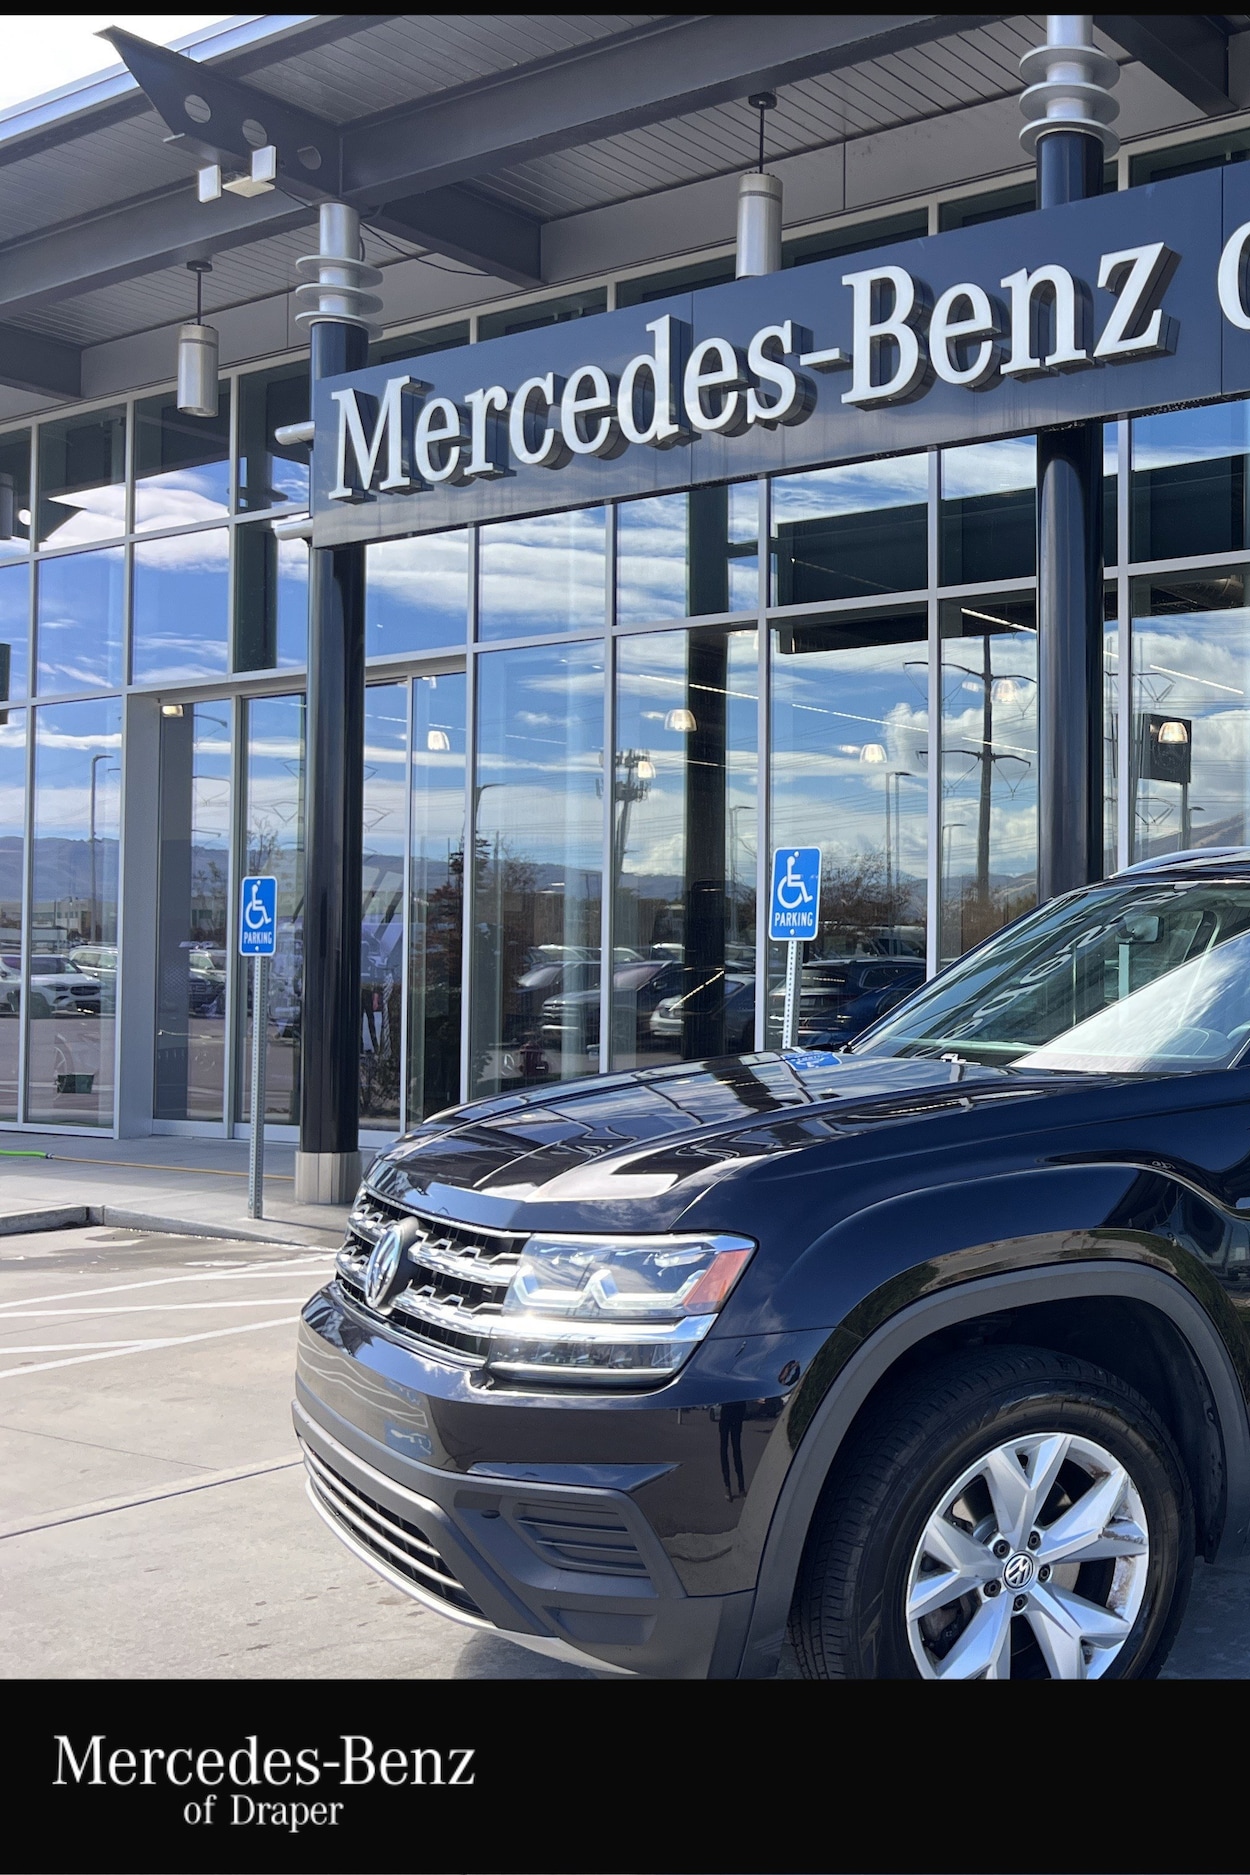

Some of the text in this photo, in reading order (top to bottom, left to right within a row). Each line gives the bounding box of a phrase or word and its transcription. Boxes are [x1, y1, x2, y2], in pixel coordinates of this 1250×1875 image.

[328, 244, 1164, 501] Mercedes-Benz
[774, 911, 813, 927] PARKING
[243, 931, 272, 944] PARKING
